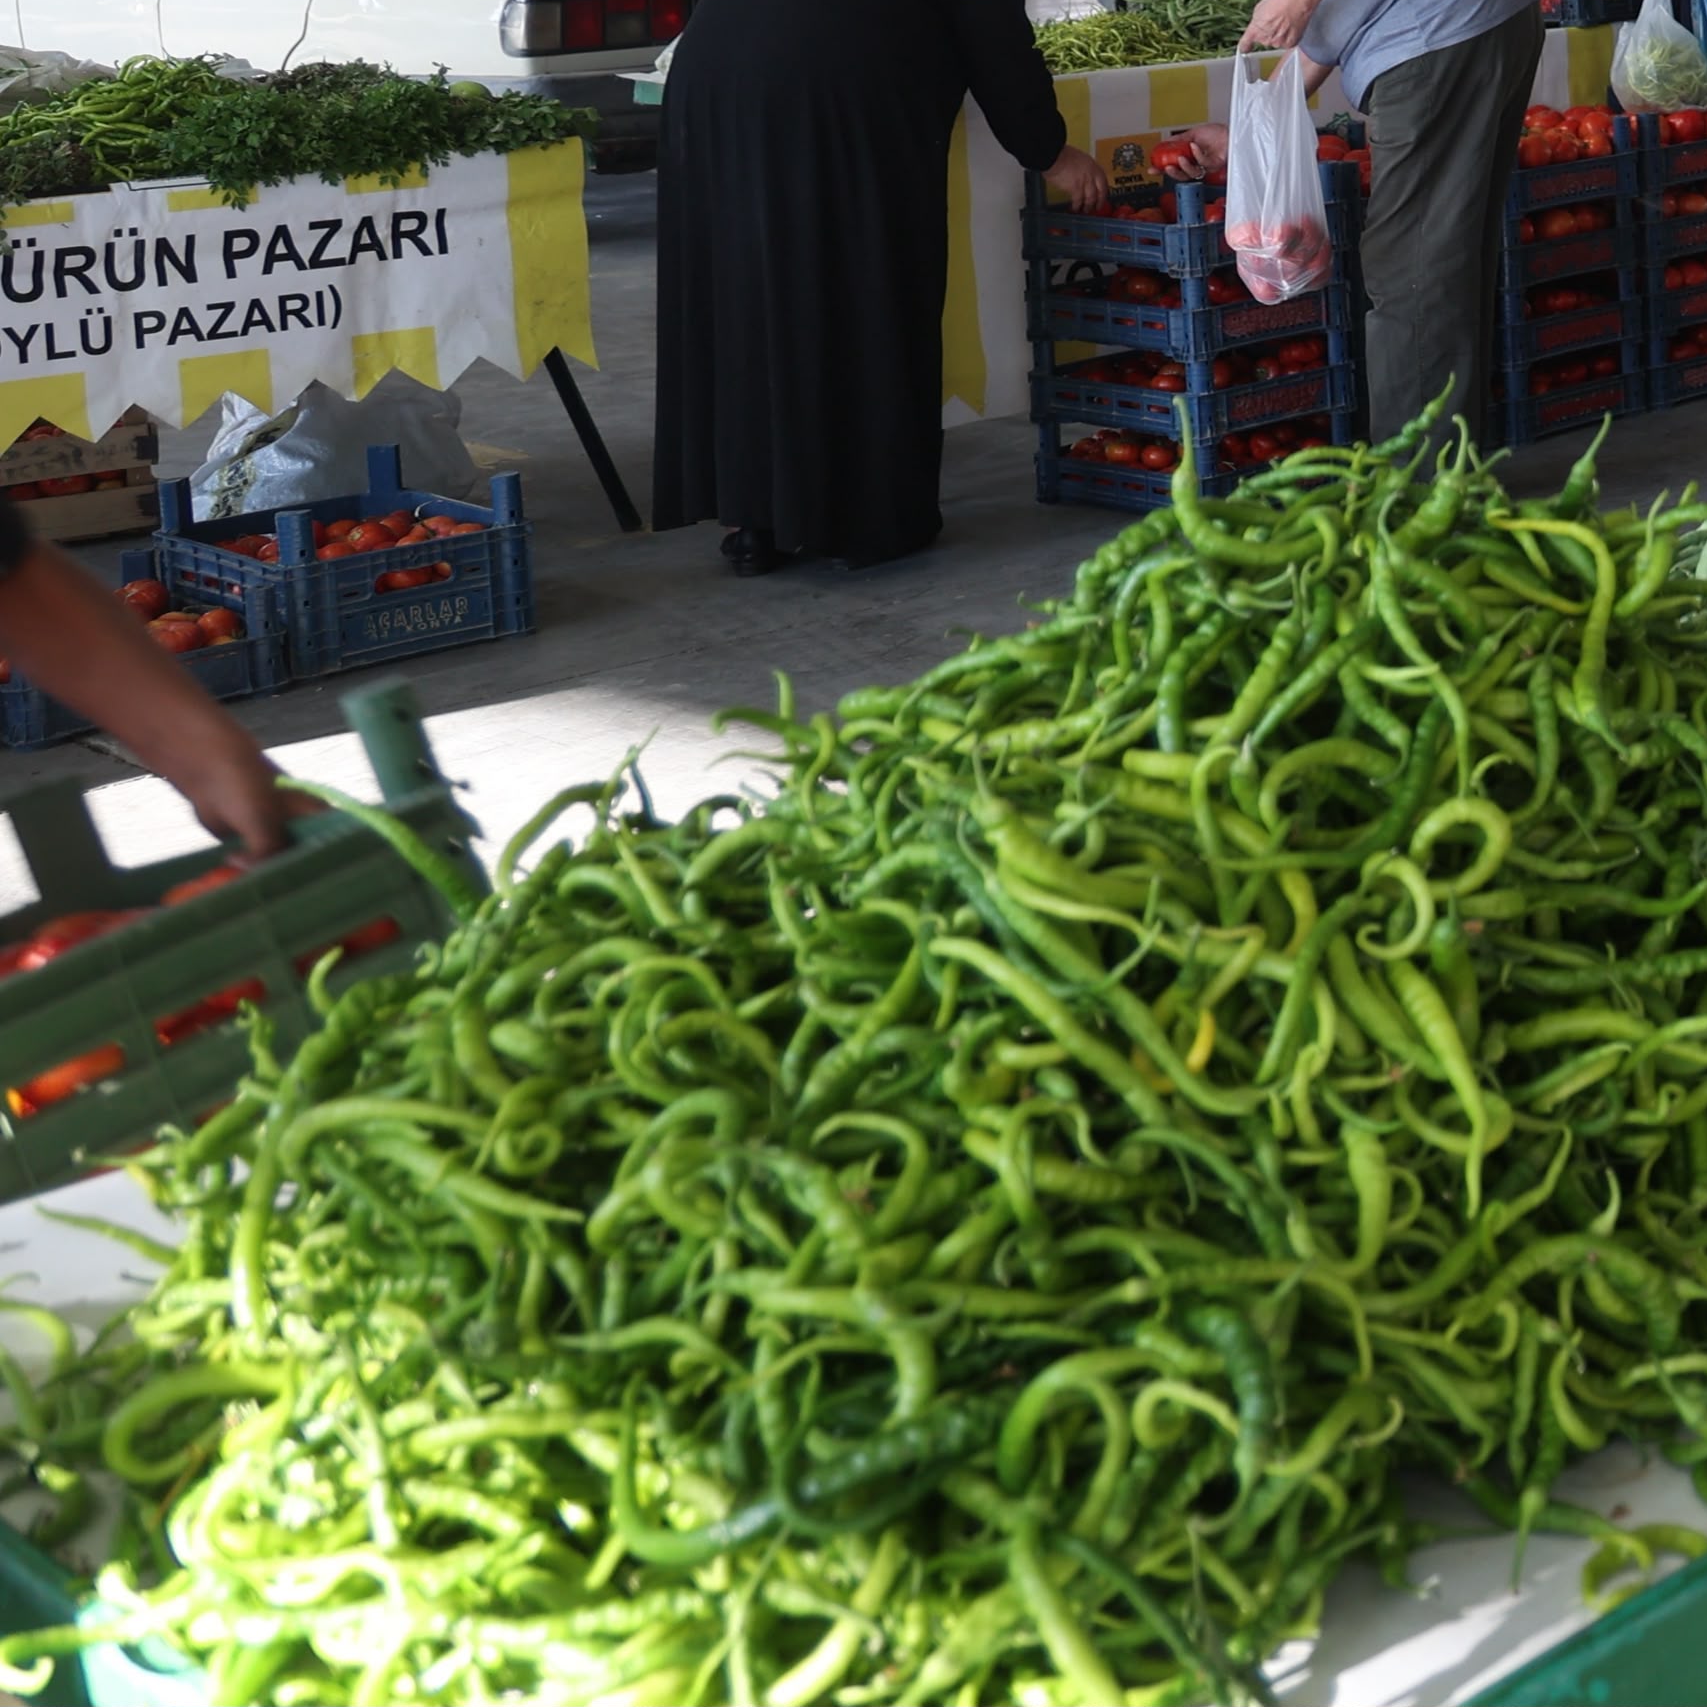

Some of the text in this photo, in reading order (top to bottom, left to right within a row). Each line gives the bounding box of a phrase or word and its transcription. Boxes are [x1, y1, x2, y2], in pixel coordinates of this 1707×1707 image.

[1114, 173, 1144, 184] KONYA
[1, 208, 449, 304] ÜRÜN PAZARI
[0, 284, 343, 365] YLÜ PAZARI)
